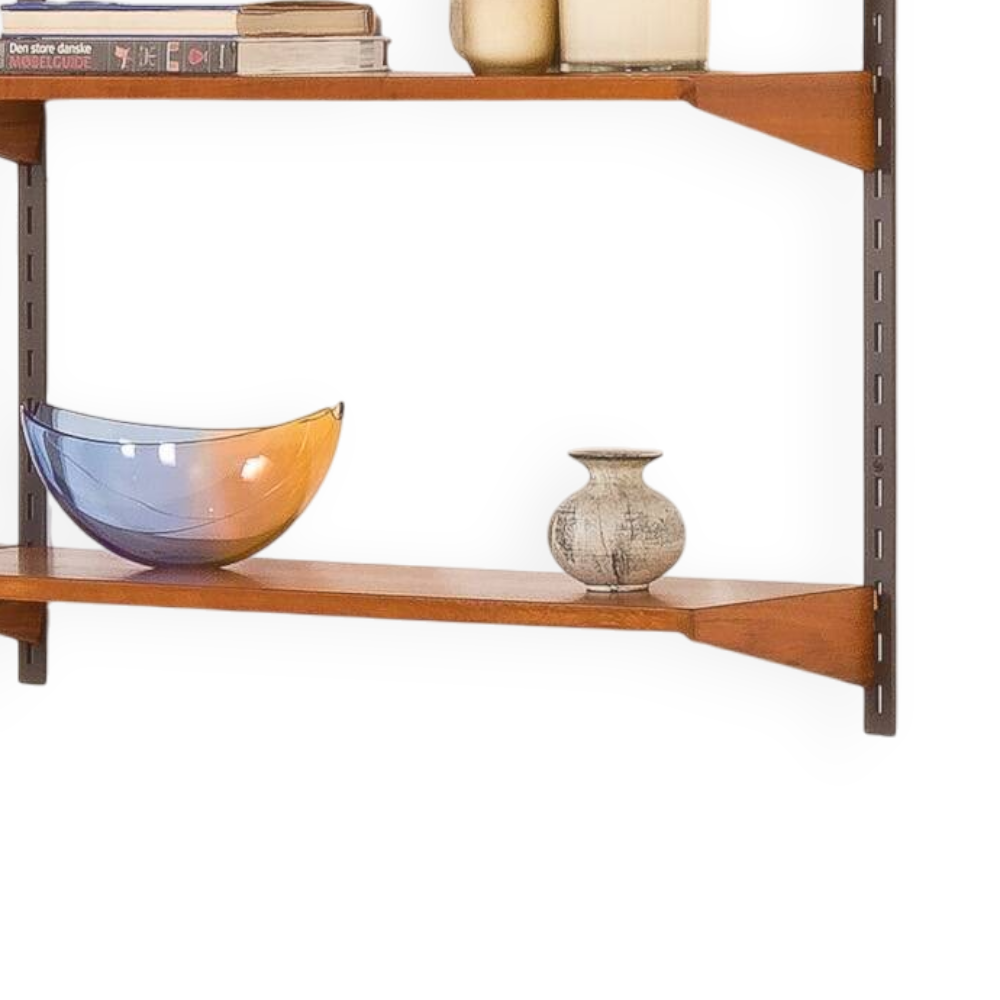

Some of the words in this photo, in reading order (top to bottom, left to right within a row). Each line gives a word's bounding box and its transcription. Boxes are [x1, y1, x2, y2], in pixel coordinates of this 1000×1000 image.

[9, 42, 29, 54] Den
[30, 43, 55, 54] store
[57, 42, 92, 54] danske
[9, 56, 92, 68] MØBELGUIDE
